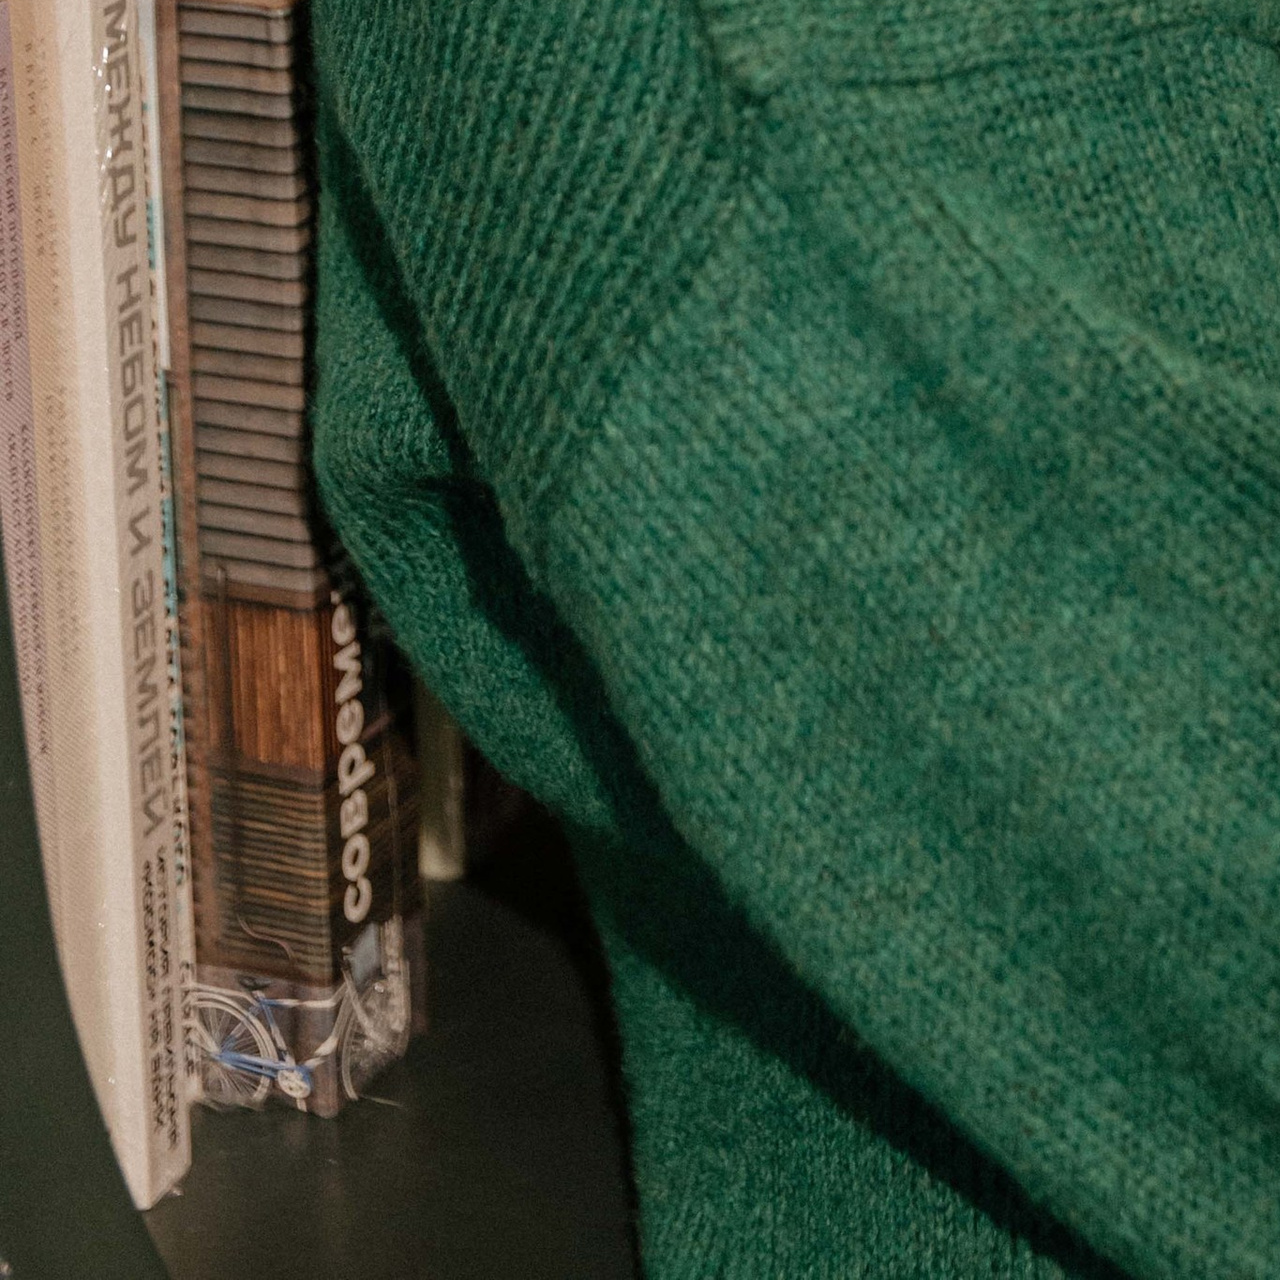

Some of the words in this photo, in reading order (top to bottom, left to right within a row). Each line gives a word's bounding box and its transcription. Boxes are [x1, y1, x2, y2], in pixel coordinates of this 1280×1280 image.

[116, 264, 149, 496] НЕБОМ
[128, 506, 153, 557] И
[131, 569, 168, 837] ЗЕМЛЕЙ
[331, 591, 374, 923] совреме
[156, 845, 170, 978] ИСТОРИЯ
